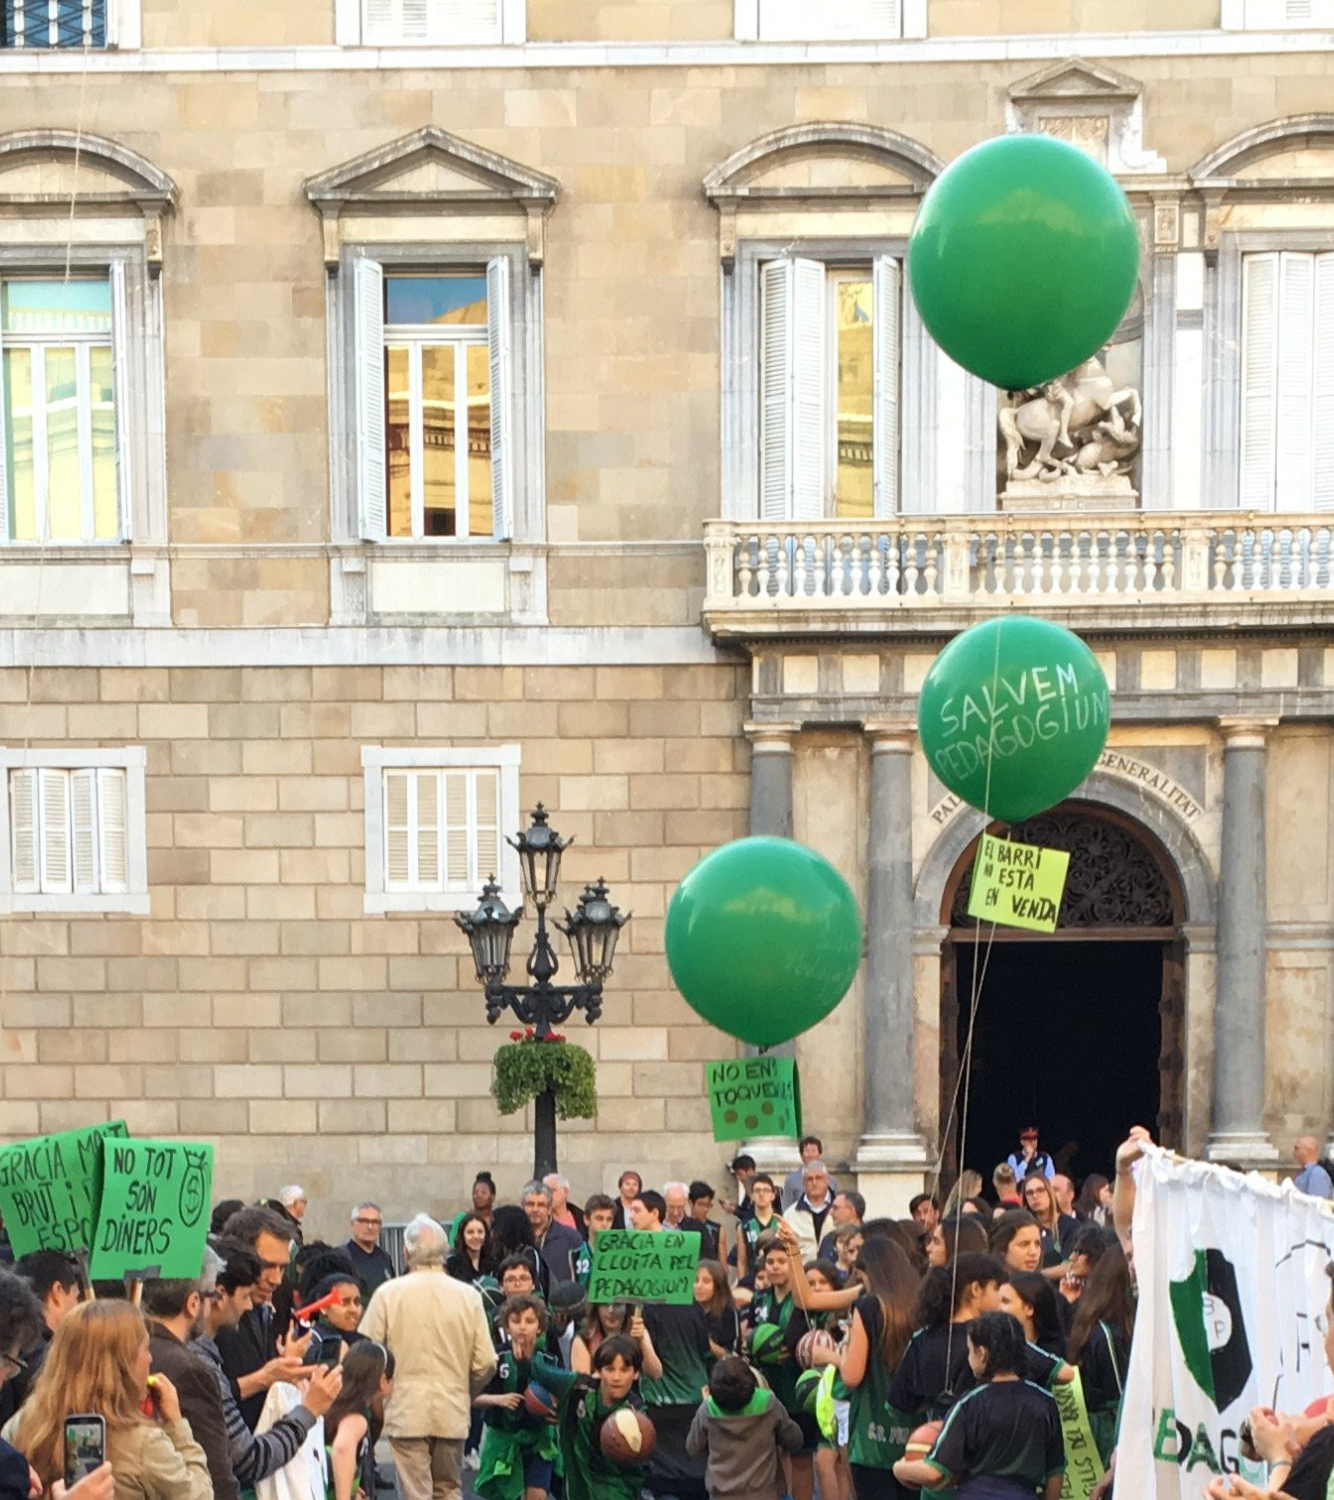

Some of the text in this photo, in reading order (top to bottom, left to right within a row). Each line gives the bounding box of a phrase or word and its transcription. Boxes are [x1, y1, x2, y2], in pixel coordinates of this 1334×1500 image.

[939, 662, 1080, 737] SALVEM
[931, 794, 963, 825] PAL
[985, 887, 1057, 924] EN VENDA
[712, 1063, 740, 1084] NO
[114, 1147, 177, 1180] NO TOT
[11, 1182, 56, 1228] BRUT
[664, 1233, 685, 1249] EN
